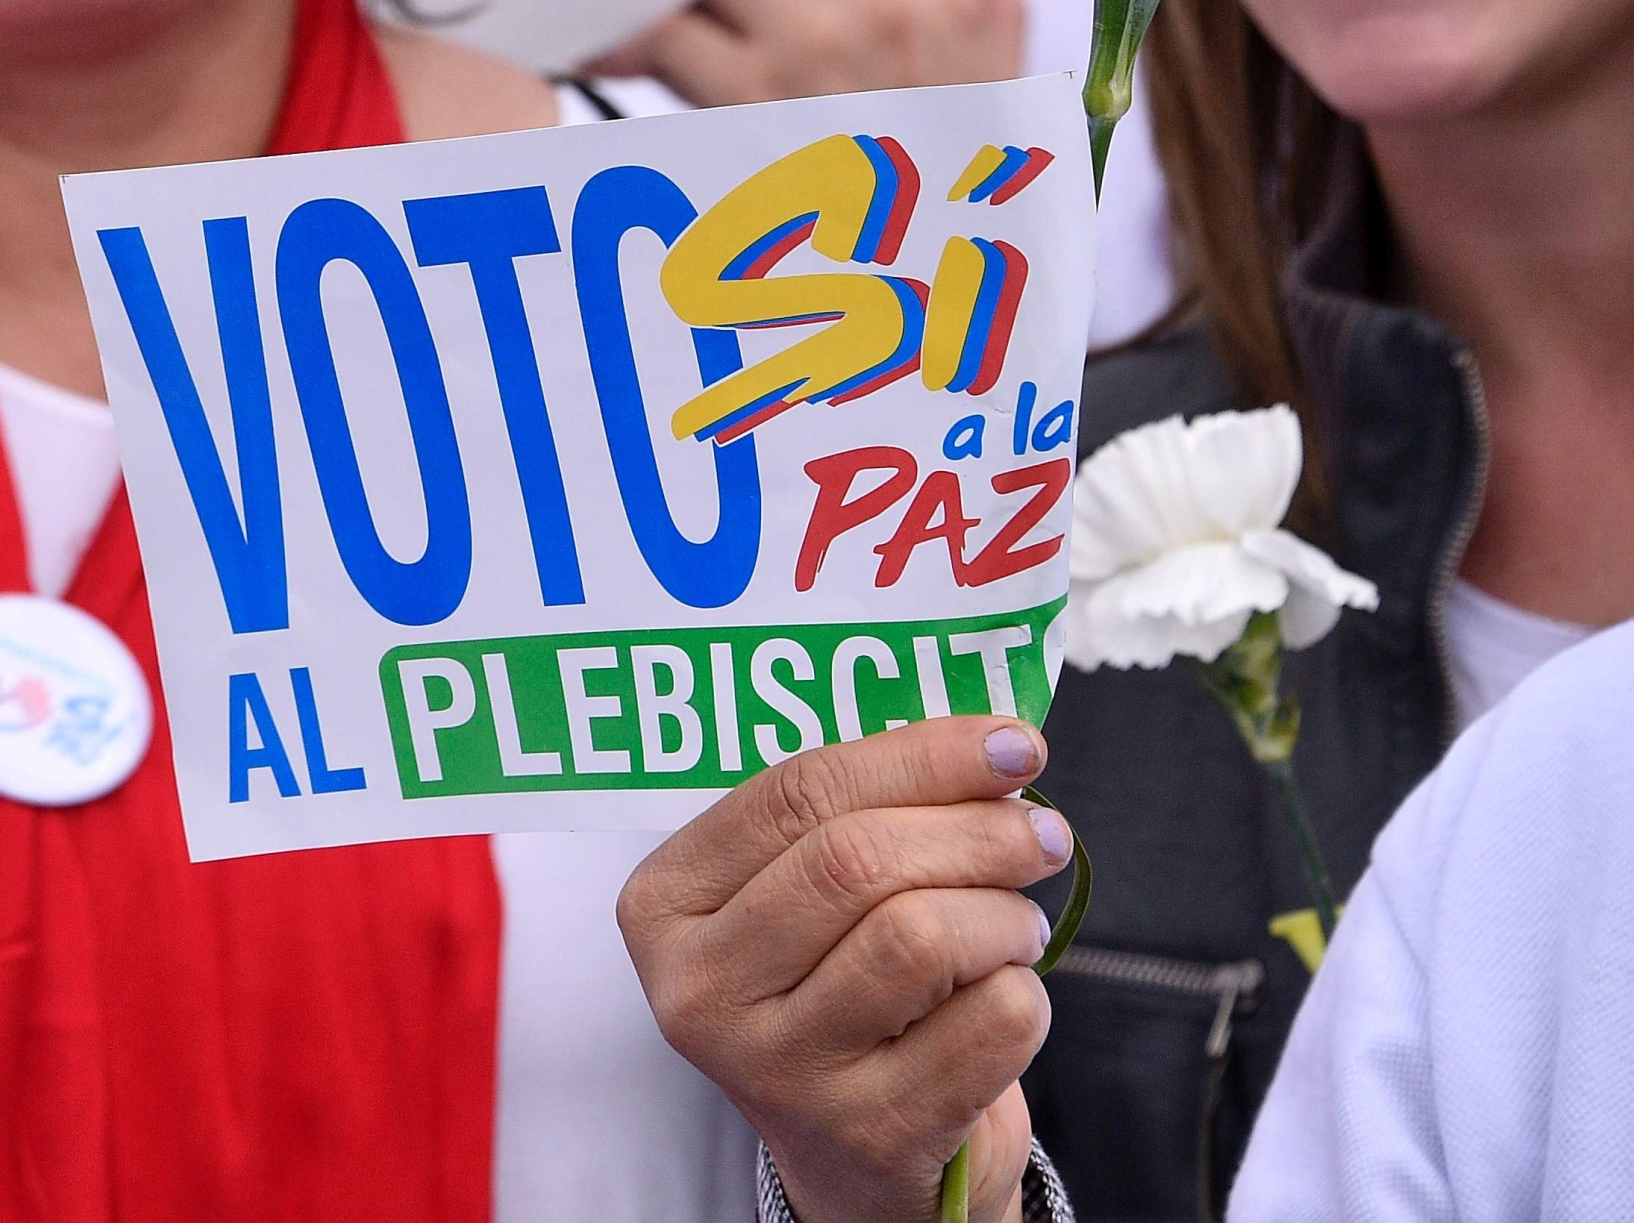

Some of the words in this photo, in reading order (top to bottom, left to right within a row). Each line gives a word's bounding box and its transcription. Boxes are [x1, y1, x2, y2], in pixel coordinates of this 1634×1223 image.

[97, 165, 762, 634] VOTO
[659, 134, 1056, 445] Sí
[943, 414, 986, 460] a
[1013, 381, 1074, 455] la
[795, 446, 1071, 592] PAZ
[229, 666, 367, 804] AL
